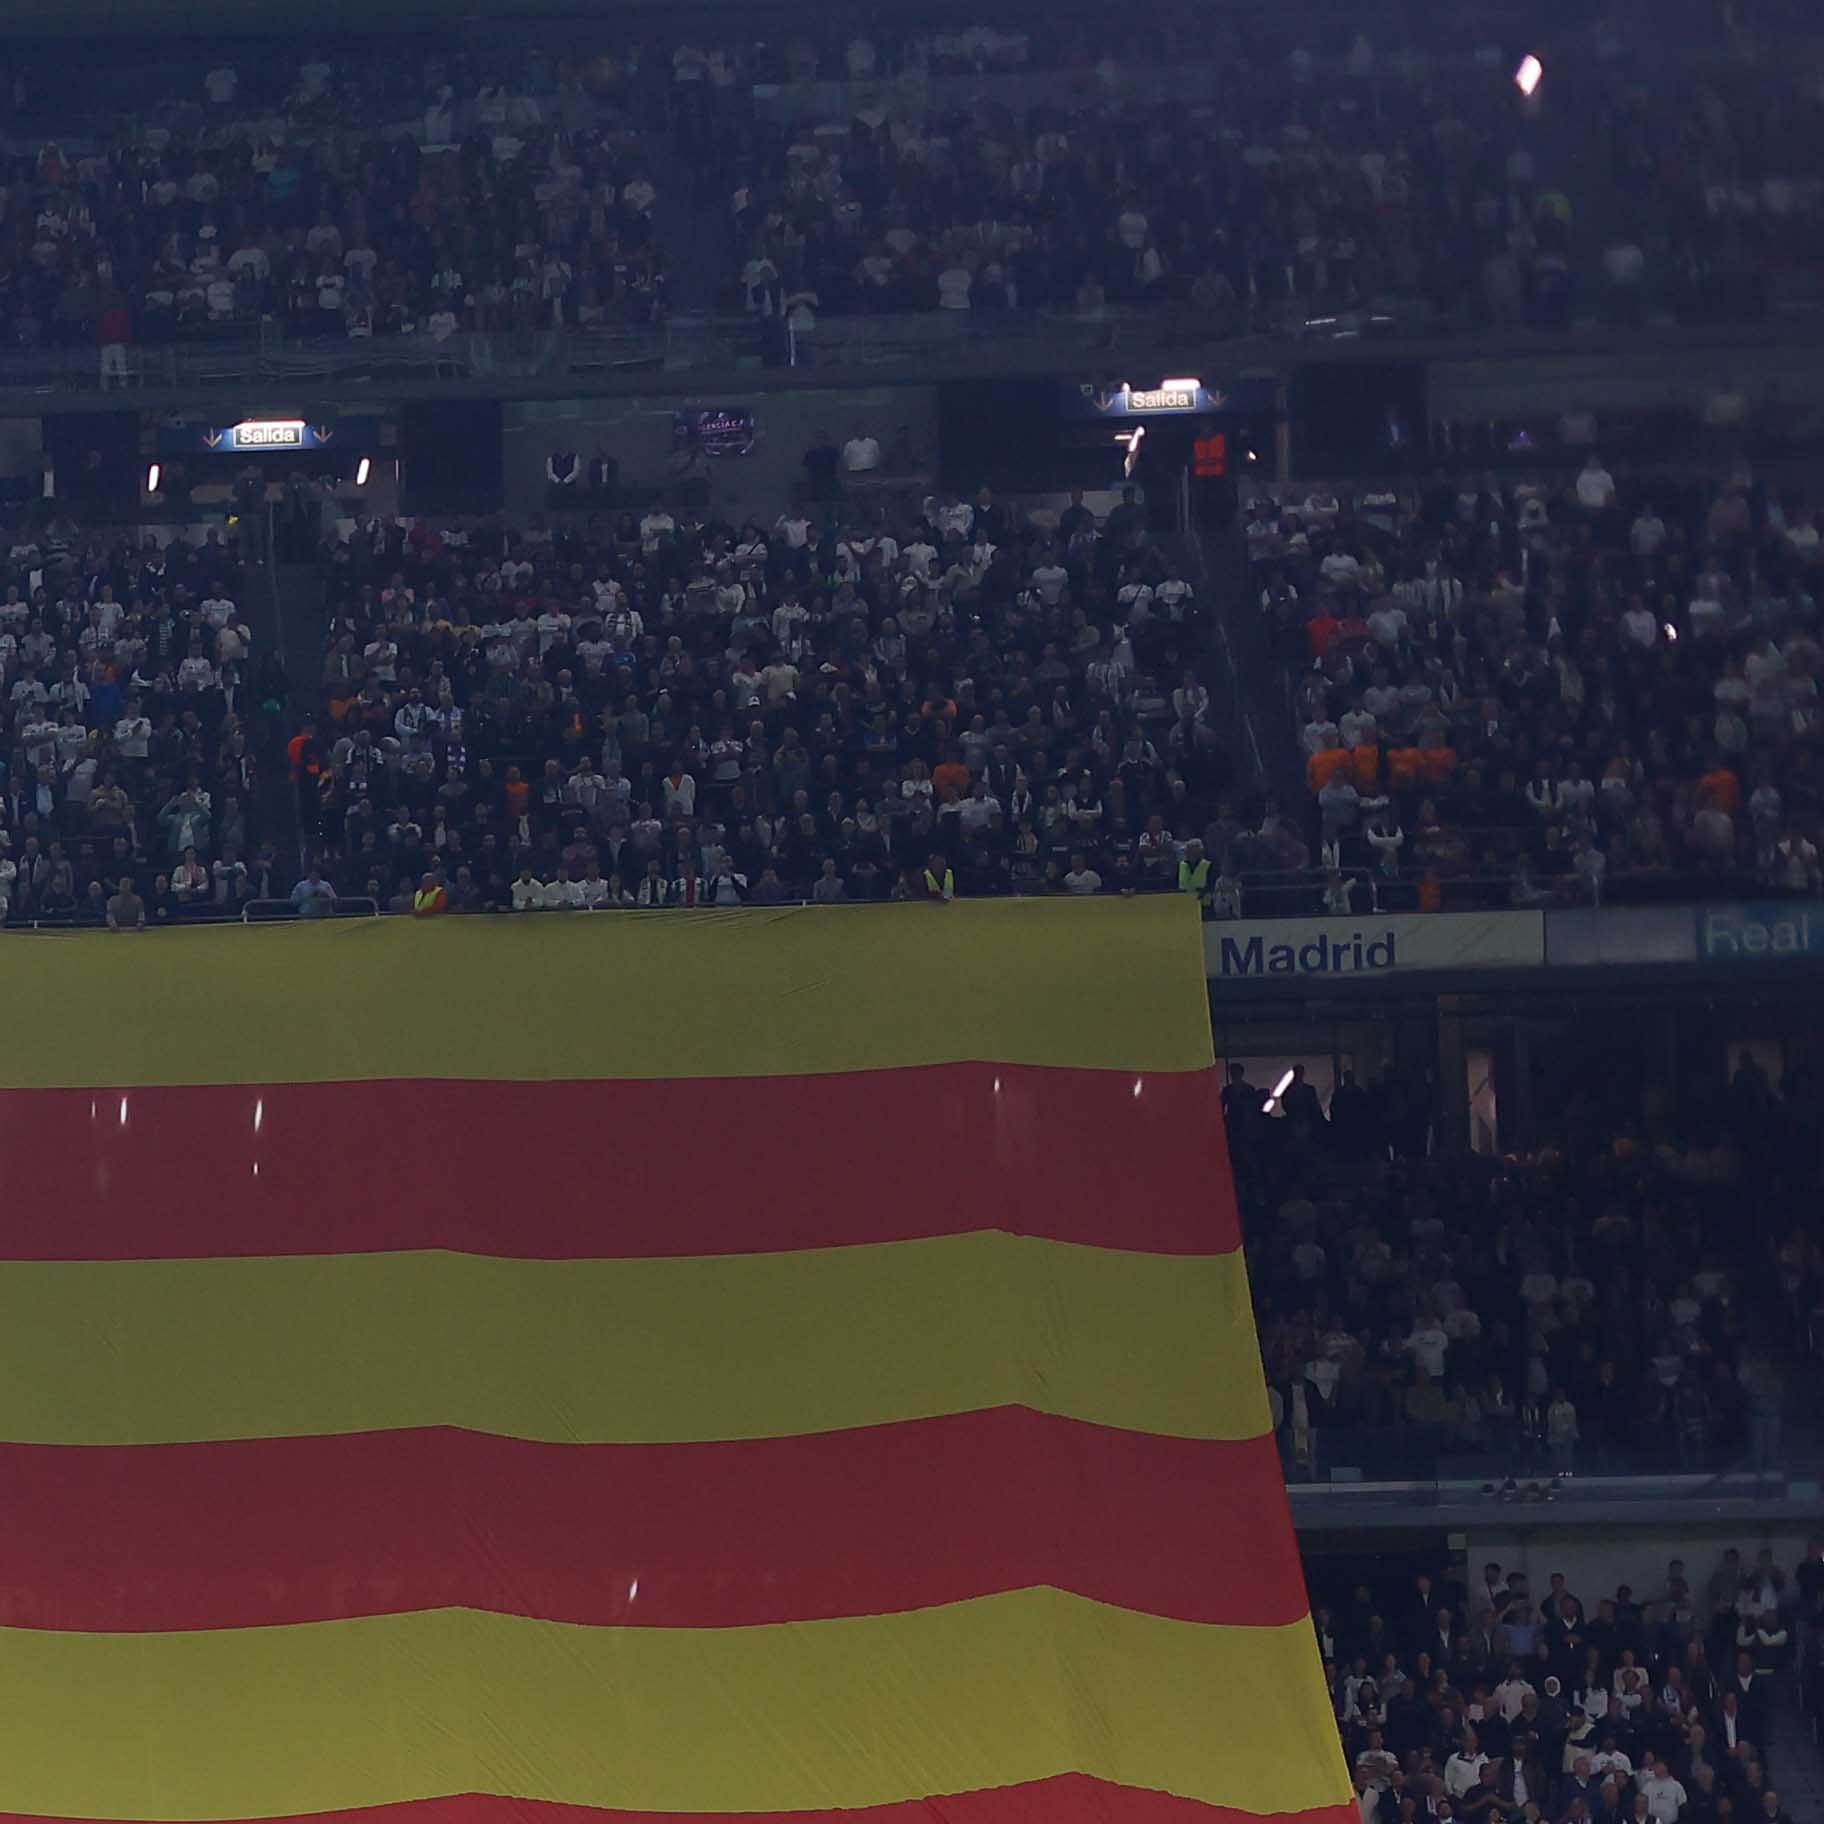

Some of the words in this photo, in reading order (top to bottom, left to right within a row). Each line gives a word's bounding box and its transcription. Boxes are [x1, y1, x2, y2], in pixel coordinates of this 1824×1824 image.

[1132, 391, 1189, 408] Salida
[240, 427, 295, 443] Salida
[1706, 911, 1809, 953] Real
[1220, 933, 1397, 977] Madrid
